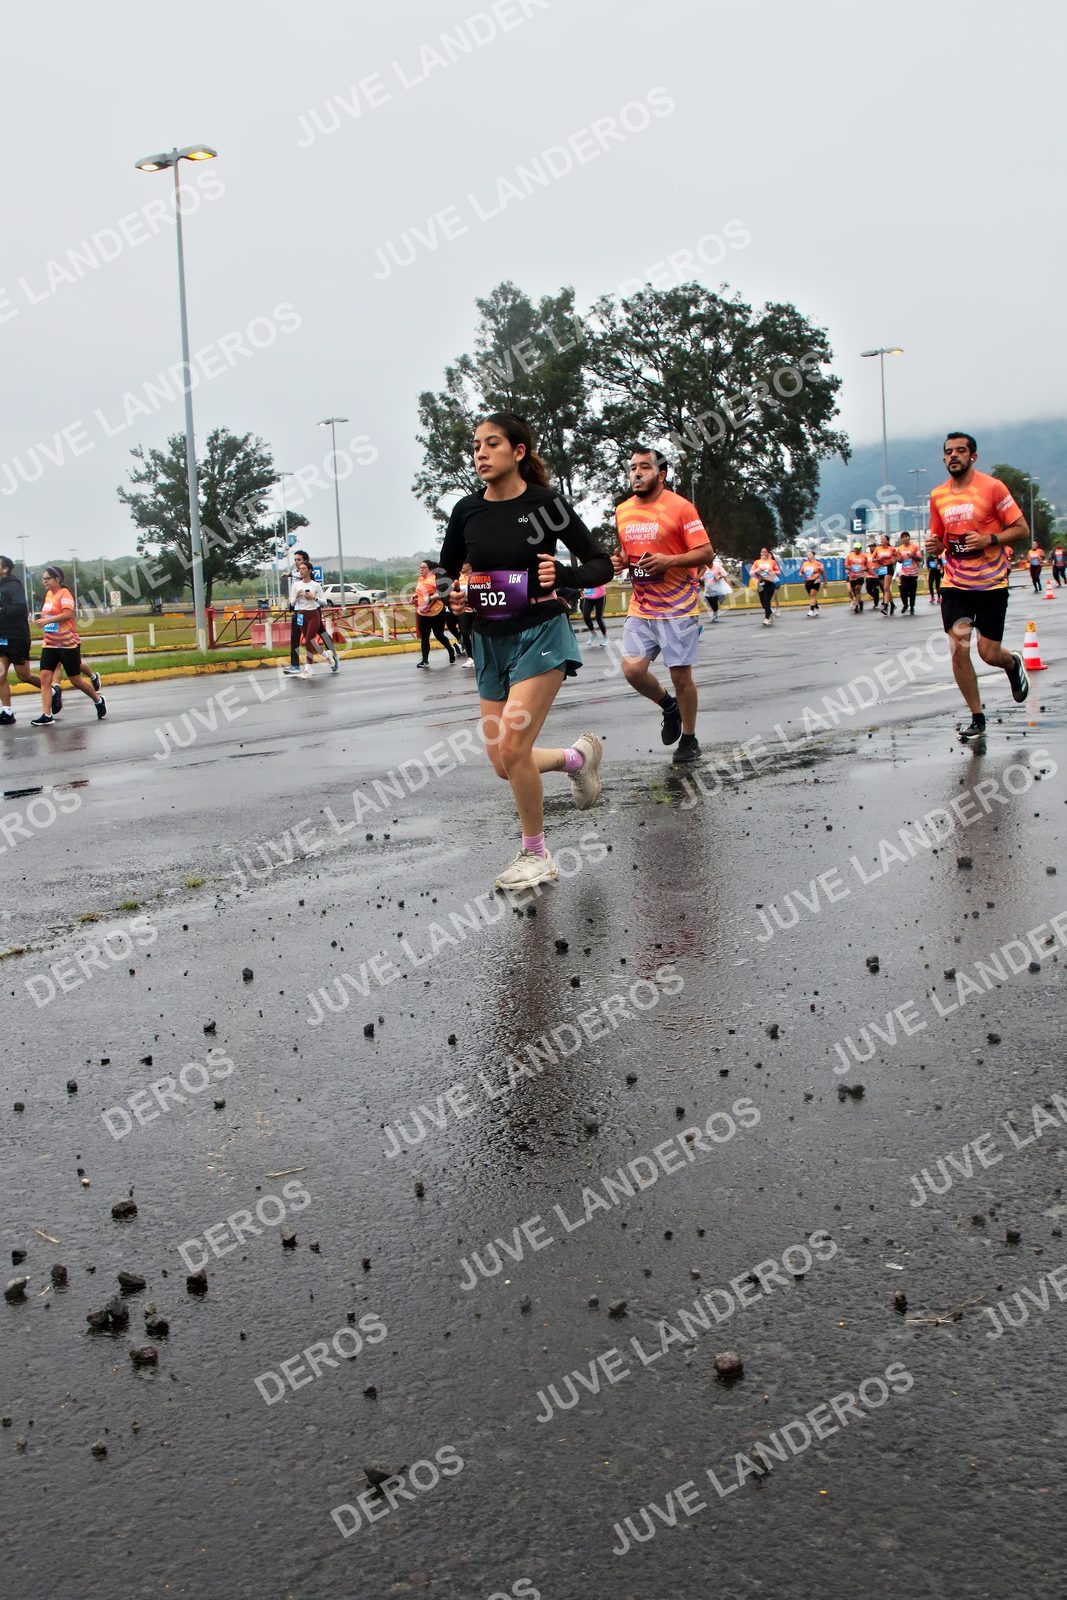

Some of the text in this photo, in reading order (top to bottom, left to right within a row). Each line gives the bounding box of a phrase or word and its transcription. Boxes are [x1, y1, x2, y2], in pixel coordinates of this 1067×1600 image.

[517, 515, 529, 523] alo
[853, 519, 862, 531] E
[508, 573, 523, 584] 16K
[480, 591, 507, 607] 502
